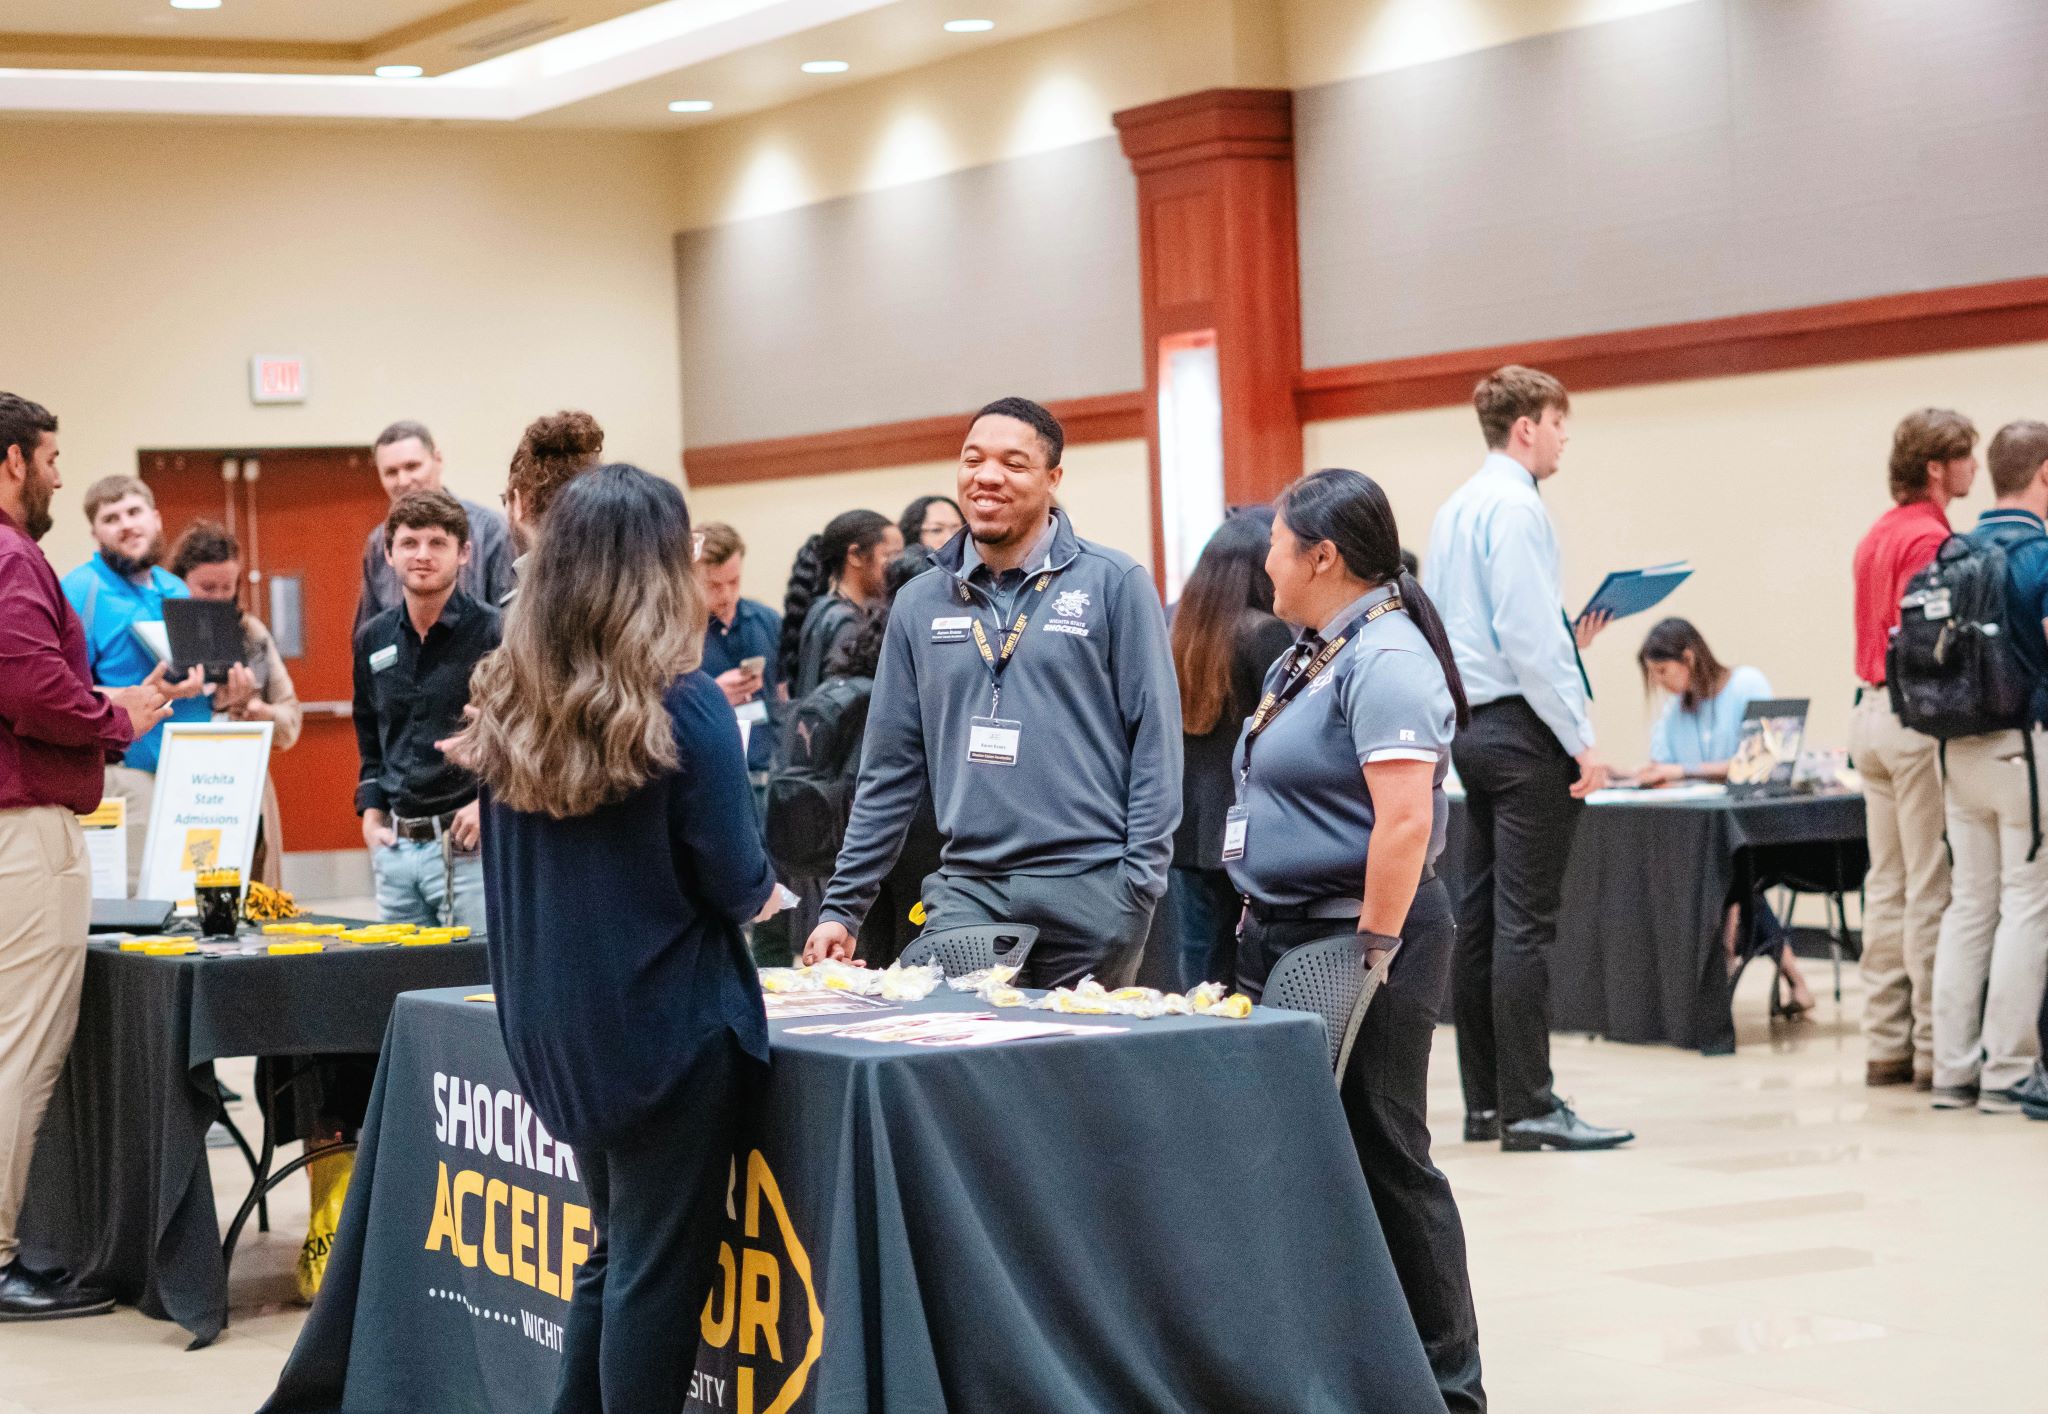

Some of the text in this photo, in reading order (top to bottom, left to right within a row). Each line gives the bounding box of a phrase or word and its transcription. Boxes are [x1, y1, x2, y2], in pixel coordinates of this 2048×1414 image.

[1001, 613, 1028, 659] WICHITA STATE
[1043, 624, 1089, 636] SHOCKERS
[1305, 636, 1346, 680] WICHITA STATE
[191, 773, 235, 785] Wichita
[195, 793, 224, 805] State
[175, 814, 239, 825] Admissions
[433, 1071, 579, 1182] SHOCKER
[424, 1160, 598, 1302] ACCELE
[687, 1370, 725, 1407] SITY
